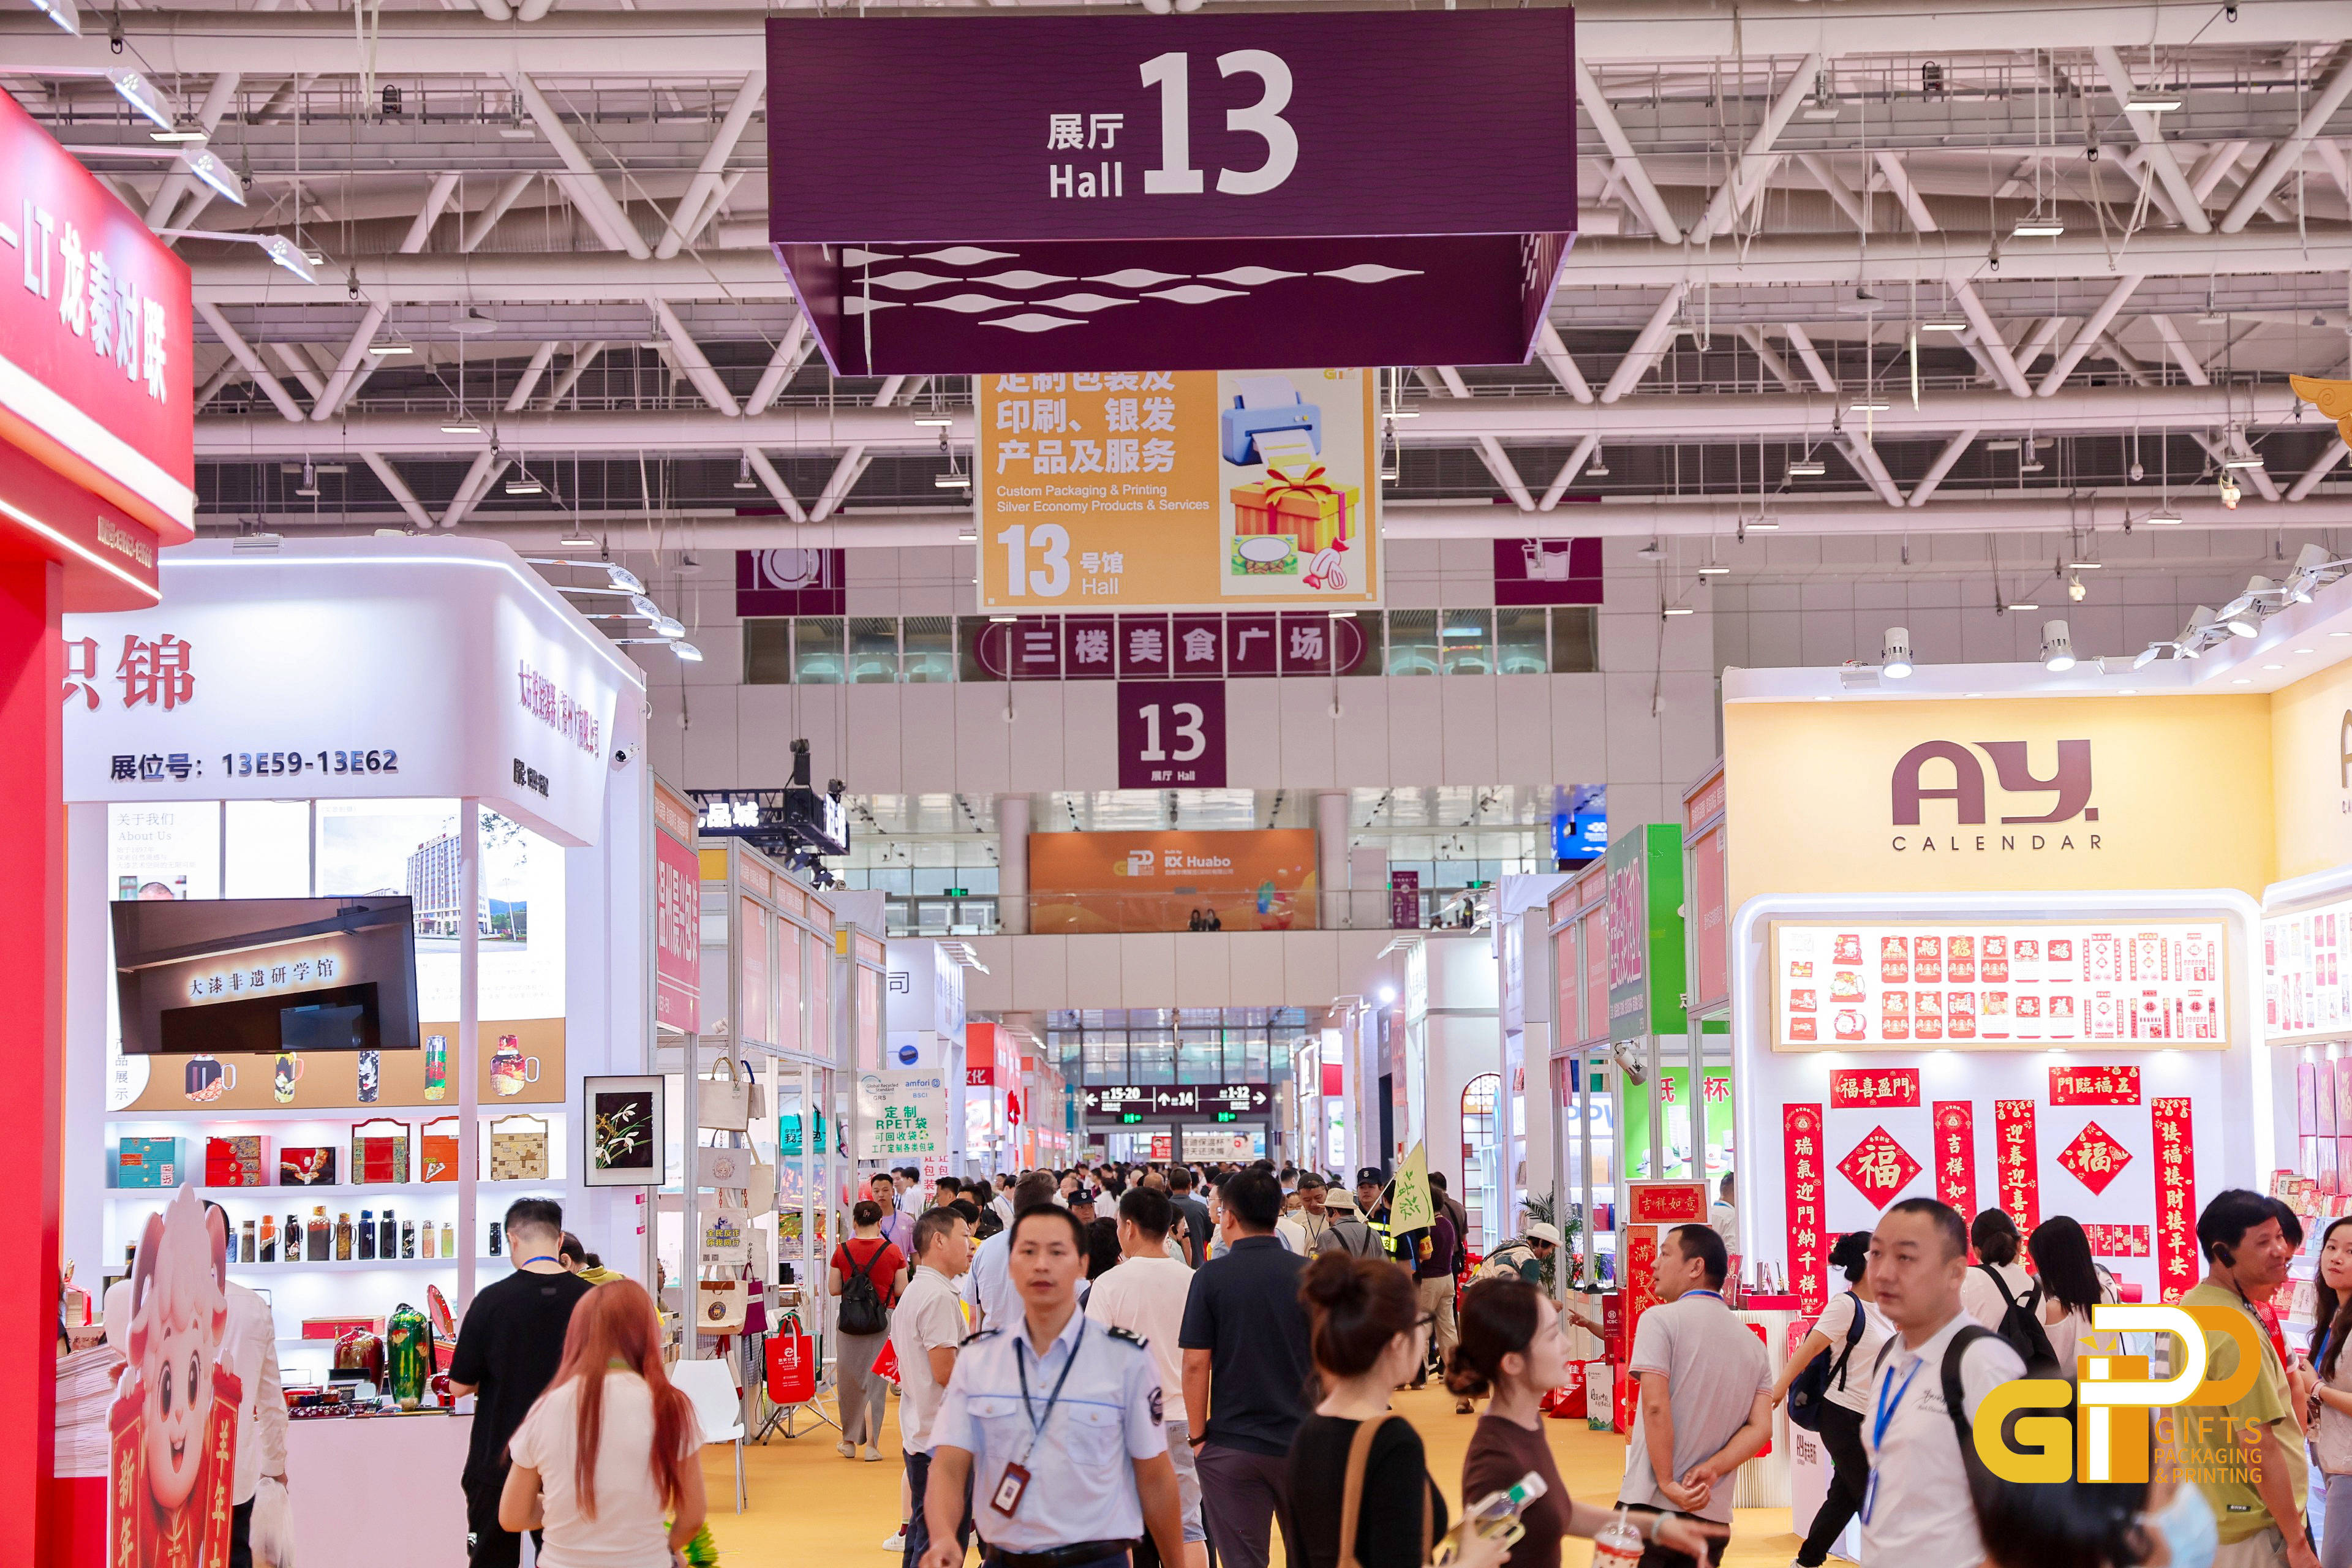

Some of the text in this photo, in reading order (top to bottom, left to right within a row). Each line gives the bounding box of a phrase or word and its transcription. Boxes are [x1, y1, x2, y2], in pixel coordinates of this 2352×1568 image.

[1046, 113, 1124, 150] 展厅
[1139, 49, 1298, 195] 13
[1049, 161, 1123, 198] Hall
[996, 439, 1176, 475] 产品及服务
[997, 484, 1167, 499] Custom Packaging & Printing
[997, 499, 1210, 514] Silver Economy Products & Services
[997, 523, 1071, 597] 13
[1079, 551, 1124, 575] 号馆
[1082, 578, 1118, 595] Hall
[1022, 627, 1324, 663] 三楼美食广场
[1139, 703, 1206, 762] 13
[222, 749, 398, 777] 13E59-13E62
[1151, 771, 1172, 782] 展厅
[1178, 771, 1195, 782] Hall
[117, 812, 175, 826] 关于我们
[697, 801, 760, 829] 品城
[118, 831, 172, 841] About Us
[1893, 834, 2101, 853] CALENDAR
[1186, 856, 1231, 867] Huabo
[187, 957, 334, 997] 大漆非遗研学馆
[888, 971, 910, 994] 司
[905, 1079, 930, 1087] amfori
[1178, 1091, 1194, 1106] 14
[872, 1142, 935, 1153] 工厂定制各类包袋
[875, 1131, 917, 1142] 可回收袋
[1856, 1144, 1901, 1188] 福
[2079, 1142, 2111, 1173] 福
[1642, 1196, 1697, 1212] 吉祥如意
[2162, 1121, 2189, 1277] 接福接財接平安
[1794, 1136, 1817, 1295] 瑞氣迎門納千祥
